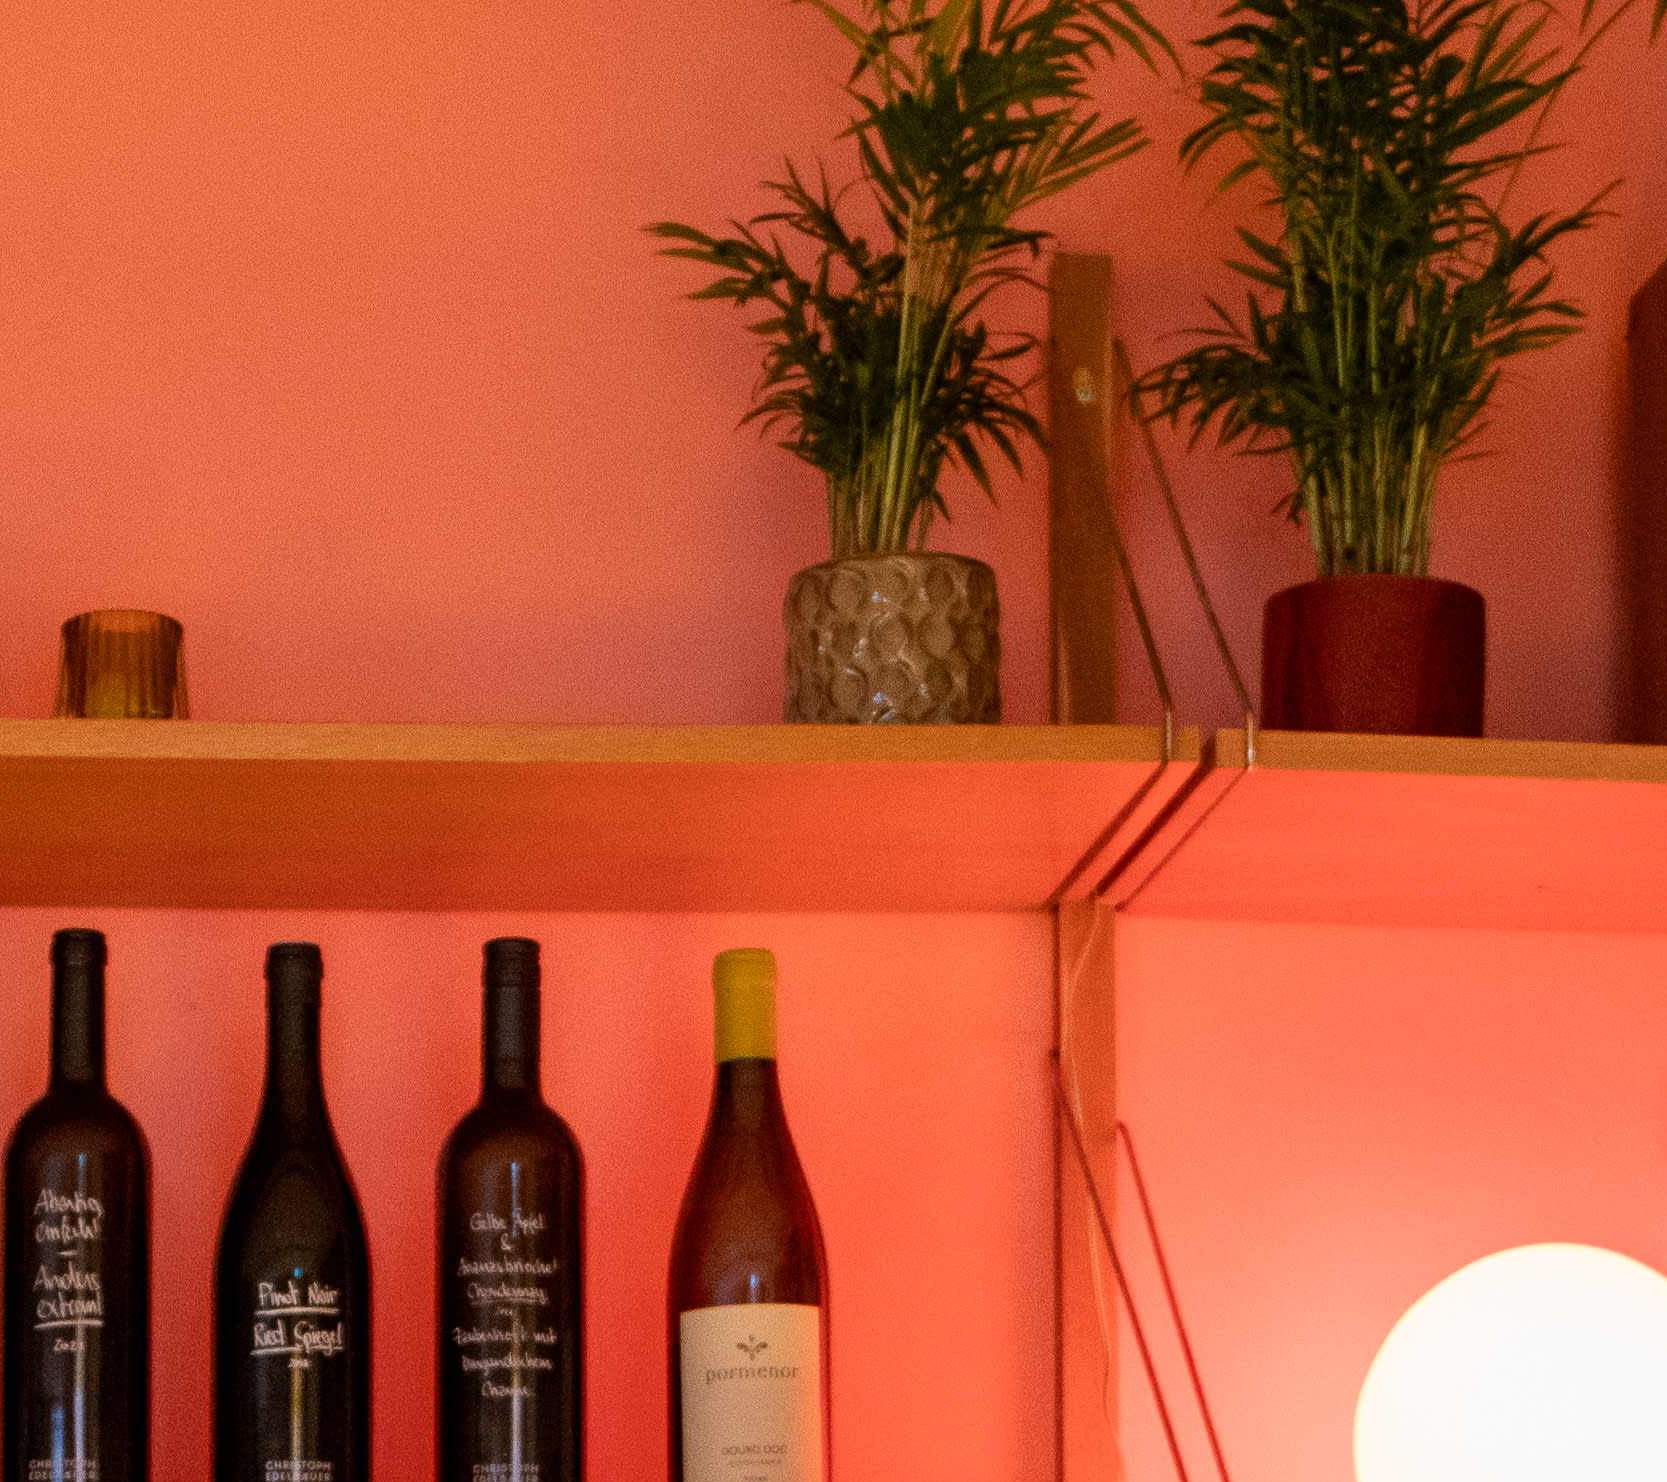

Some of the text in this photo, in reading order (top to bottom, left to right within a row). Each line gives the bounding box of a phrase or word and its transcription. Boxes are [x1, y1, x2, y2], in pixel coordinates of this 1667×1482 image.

[257, 1280, 340, 1306] Pinot Noir
[294, 1320, 345, 1358] Spiegel
[705, 1366, 800, 1386] pormenor
[264, 1460, 332, 1471] CHRITOPH
[473, 1462, 540, 1473] CHRISTPH
[264, 1472, 332, 1482] EDELAUER
